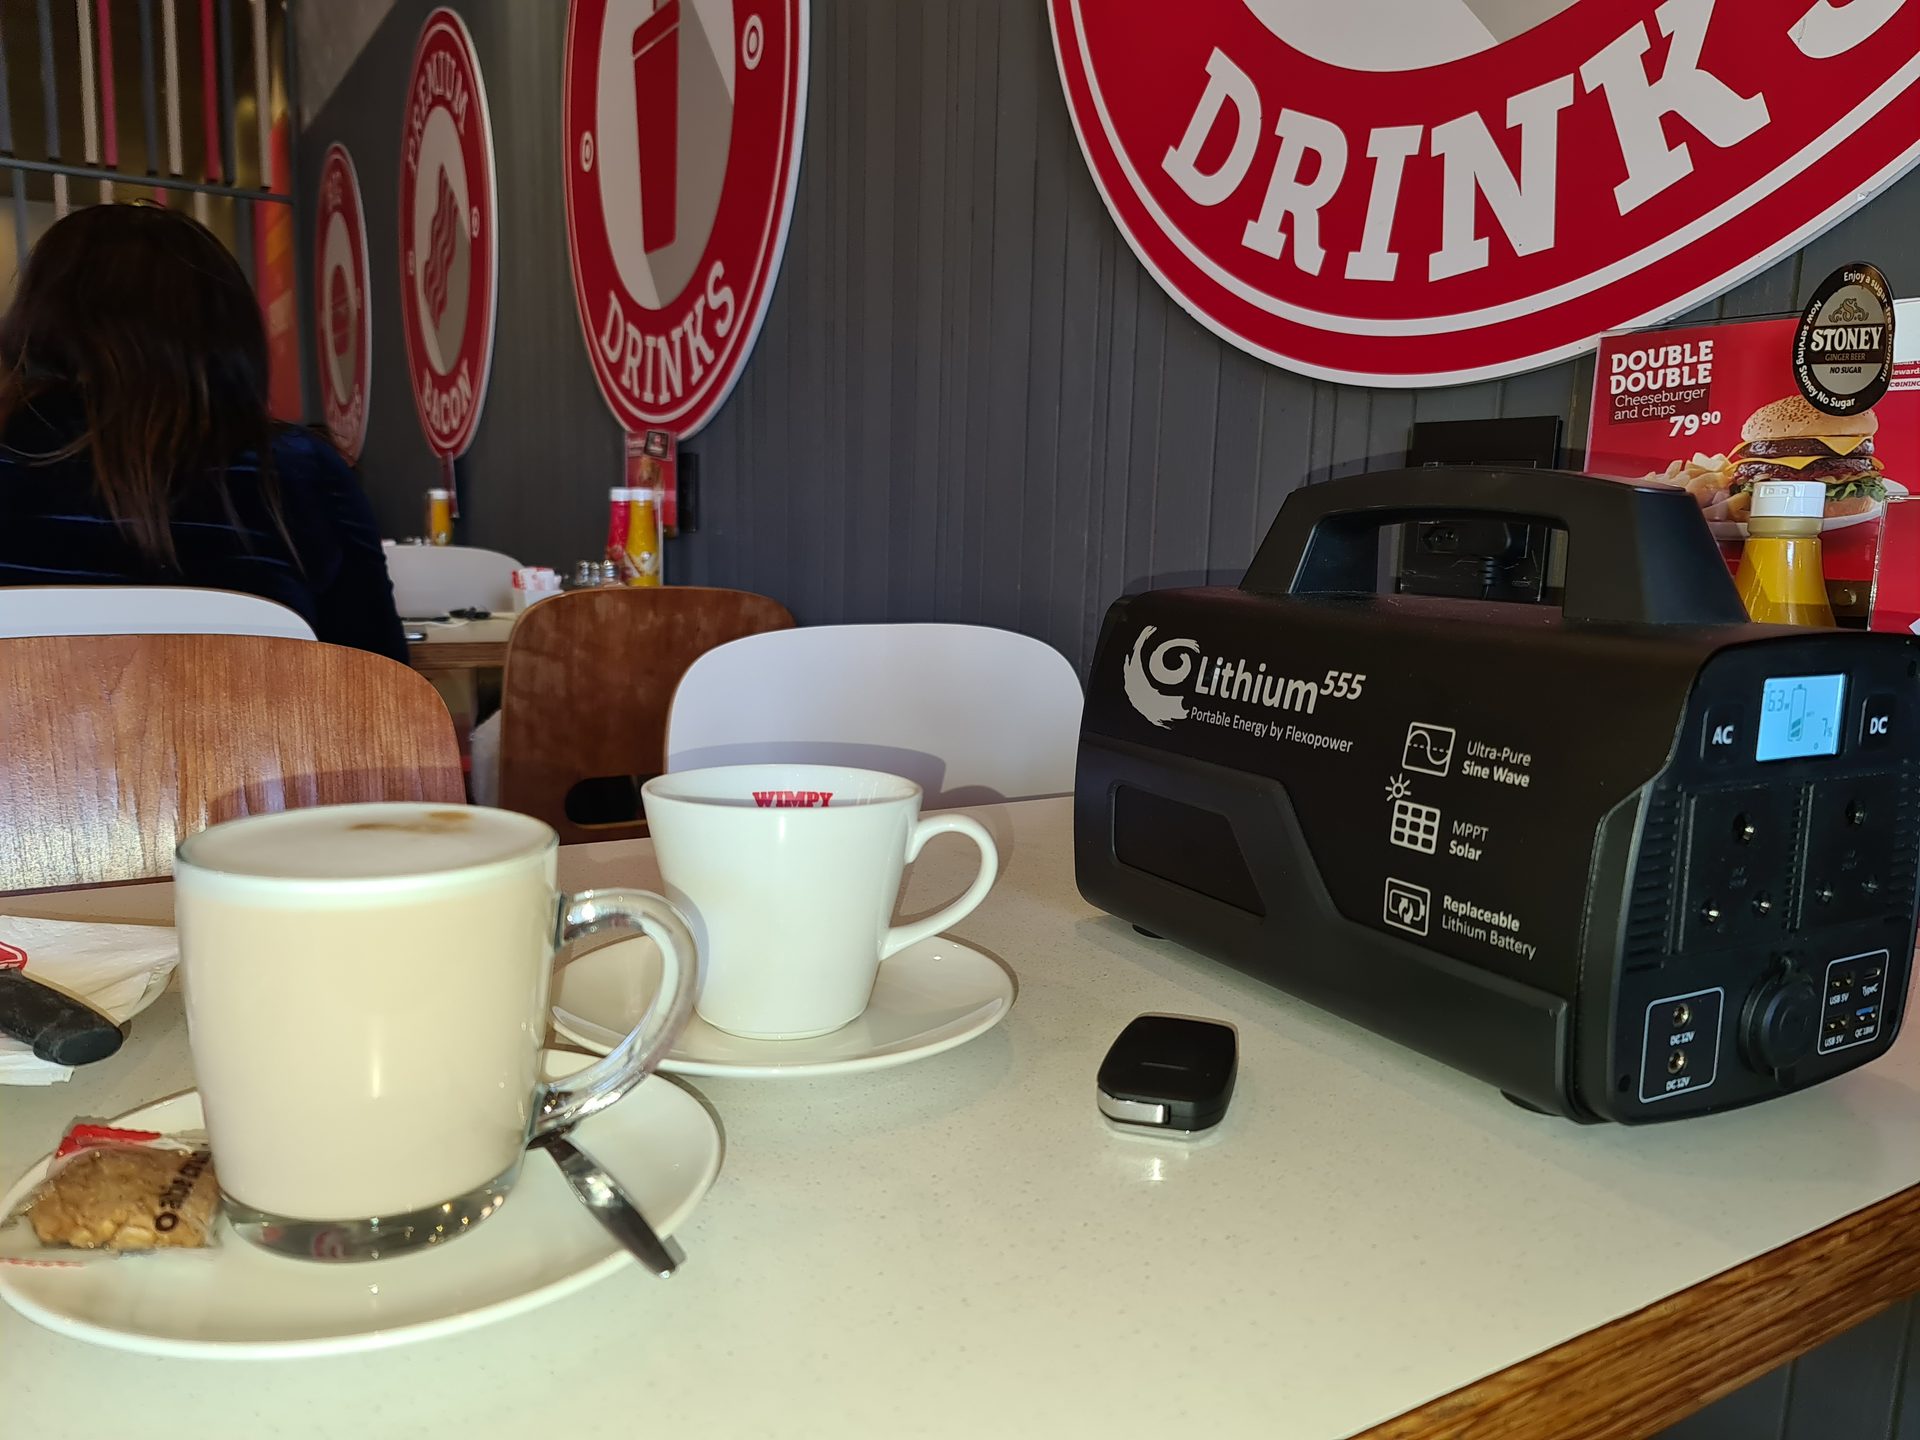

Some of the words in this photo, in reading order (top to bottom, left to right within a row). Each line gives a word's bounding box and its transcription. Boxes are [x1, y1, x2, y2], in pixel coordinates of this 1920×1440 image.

[1843, 270, 1866, 284] Enjoy
[1807, 300, 1823, 325] Now
[1870, 279, 1893, 333] sugar-free
[600, 261, 736, 404] DRINKS
[1796, 325, 1810, 365] serving
[1810, 326, 1884, 352] STONEY
[1611, 340, 1714, 374] DOUBLE
[1824, 353, 1849, 362] GINGER
[1850, 352, 1866, 361] BEER
[1829, 366, 1840, 374] NO
[1840, 366, 1862, 374] SUGAR
[1880, 333, 1893, 383] moment
[1609, 363, 1712, 395] DOUBLE
[1798, 365, 1818, 398] Stoney
[1892, 367, 1920, 376] eward
[422, 358, 472, 435] BACON
[1614, 388, 1707, 408] Cheeseburger
[1816, 391, 1829, 405] No
[1829, 397, 1856, 410] Sugar
[1614, 406, 1638, 420] and
[1641, 404, 1676, 418] chips
[1195, 655, 1319, 714] Lithium
[1319, 670, 1367, 700] 555
[1190, 706, 1231, 728] Portable
[1233, 715, 1268, 738] Energy
[1269, 721, 1285, 741] by
[1285, 725, 1354, 753] Flexopower
[1711, 725, 1735, 745] AC
[1869, 716, 1889, 735] DC
[1467, 740, 1532, 767] Ultra-Pure
[1462, 760, 1490, 779] Sine
[1493, 766, 1531, 788] Wave
[752, 791, 834, 808] WIMPY
[1452, 820, 1489, 842] MPPT
[1449, 839, 1482, 861] Solar
[1443, 895, 1521, 933] Replaceable
[1441, 914, 1487, 942] Lithium
[1489, 932, 1537, 961] Battery
